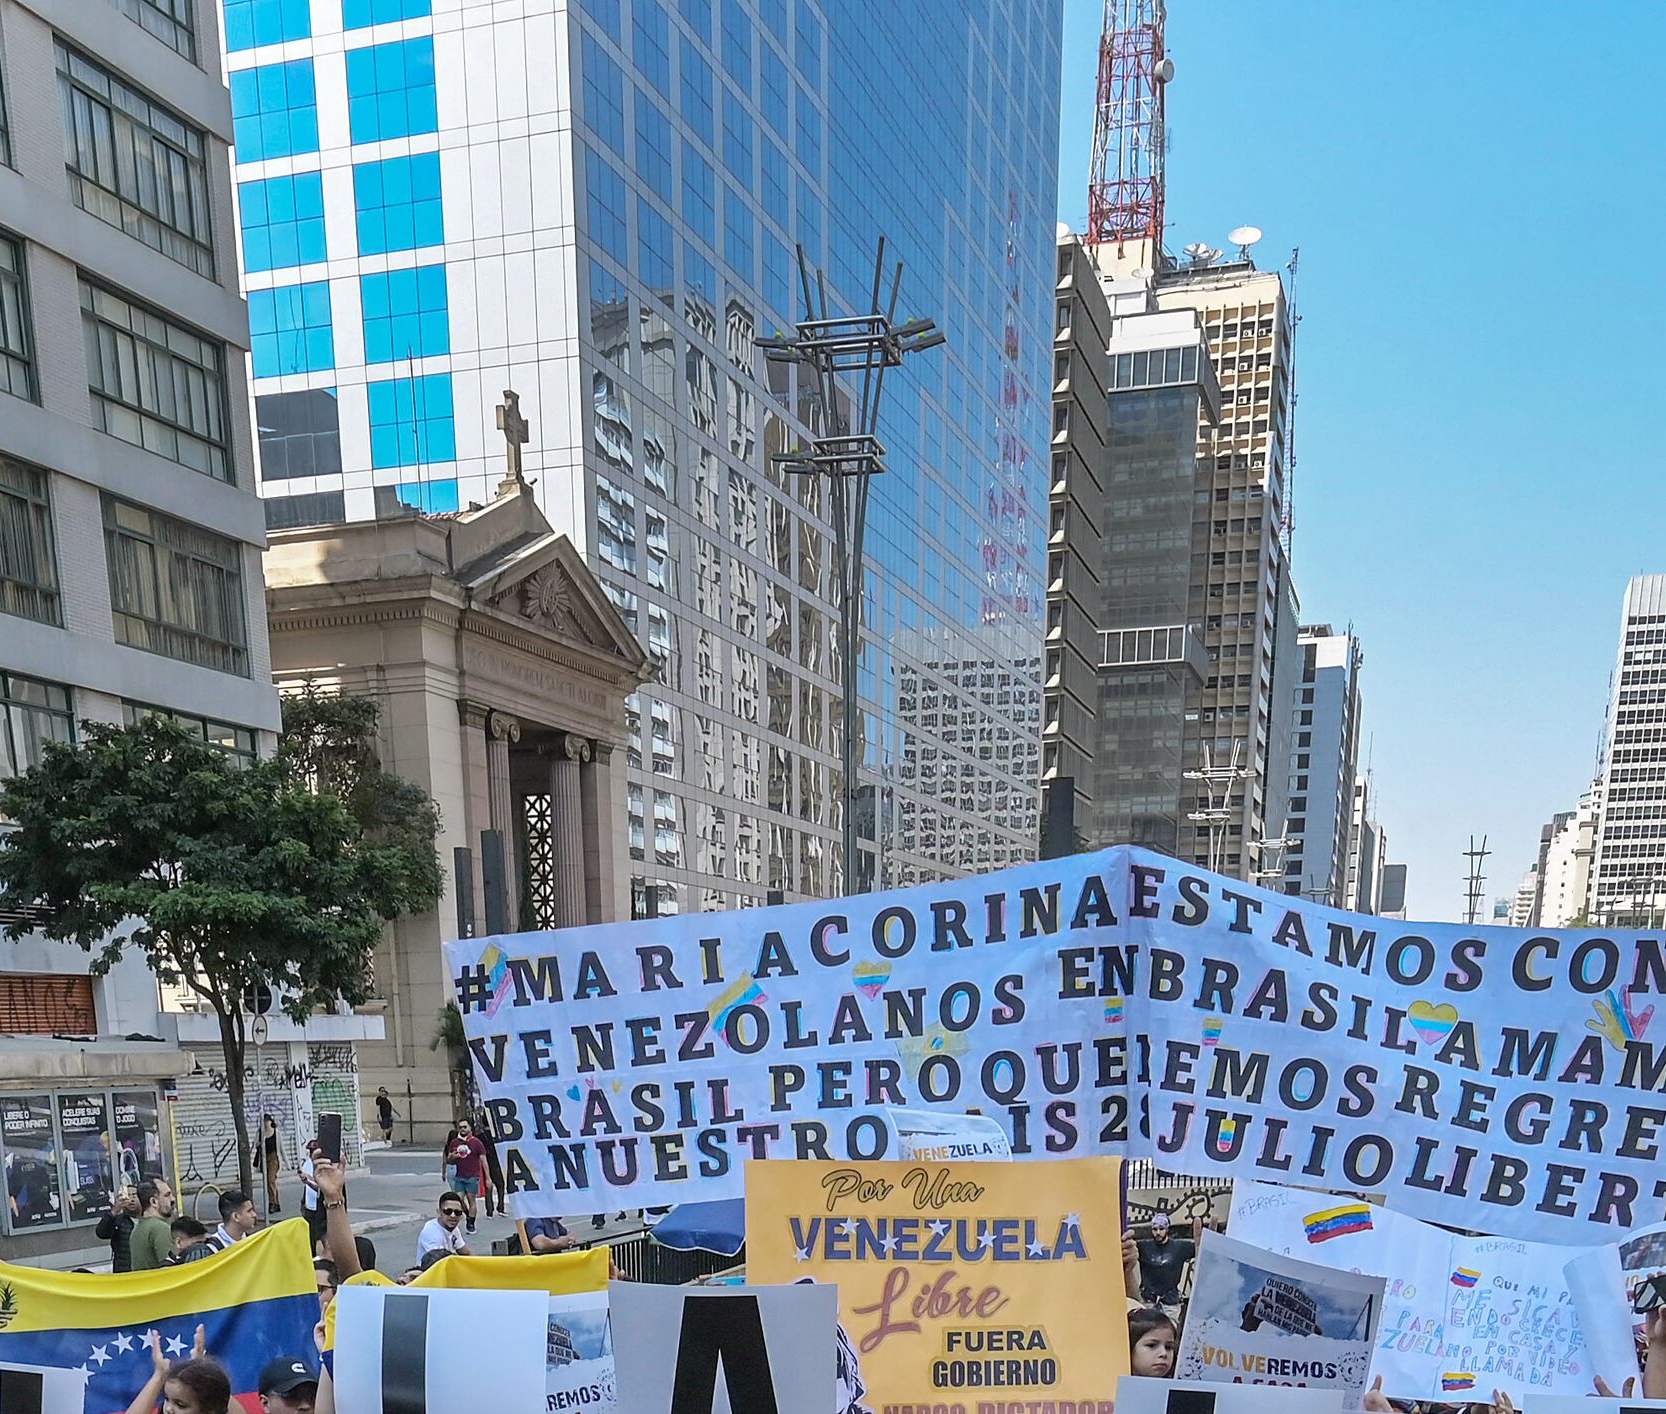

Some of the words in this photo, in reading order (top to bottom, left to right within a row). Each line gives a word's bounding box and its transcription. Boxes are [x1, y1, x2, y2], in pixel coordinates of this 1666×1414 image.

[1129, 864, 1485, 993] ESTAMOS
[468, 973, 1026, 1083] VENEZOLANOS
[1150, 948, 1417, 1056] BRASIL
[62, 1108, 86, 1118] ACELERE
[484, 1075, 744, 1143] BRASIL
[769, 1052, 964, 1113] PERO
[5, 1120, 25, 1130] PODER
[1155, 1101, 1393, 1187] JULIO
[912, 1142, 993, 1162] VENEZUELA
[821, 1168, 894, 1212] Por
[901, 1168, 985, 1211] Una
[788, 1212, 1090, 1263] VENEZUELA
[853, 1266, 1009, 1354] Libre
[1451, 1288, 1492, 1310] ME
[946, 1329, 1047, 1353] FUERA
[932, 1358, 1057, 1388] GOBIERNO
[1201, 1345, 1338, 1380] VOLVEREMOS
